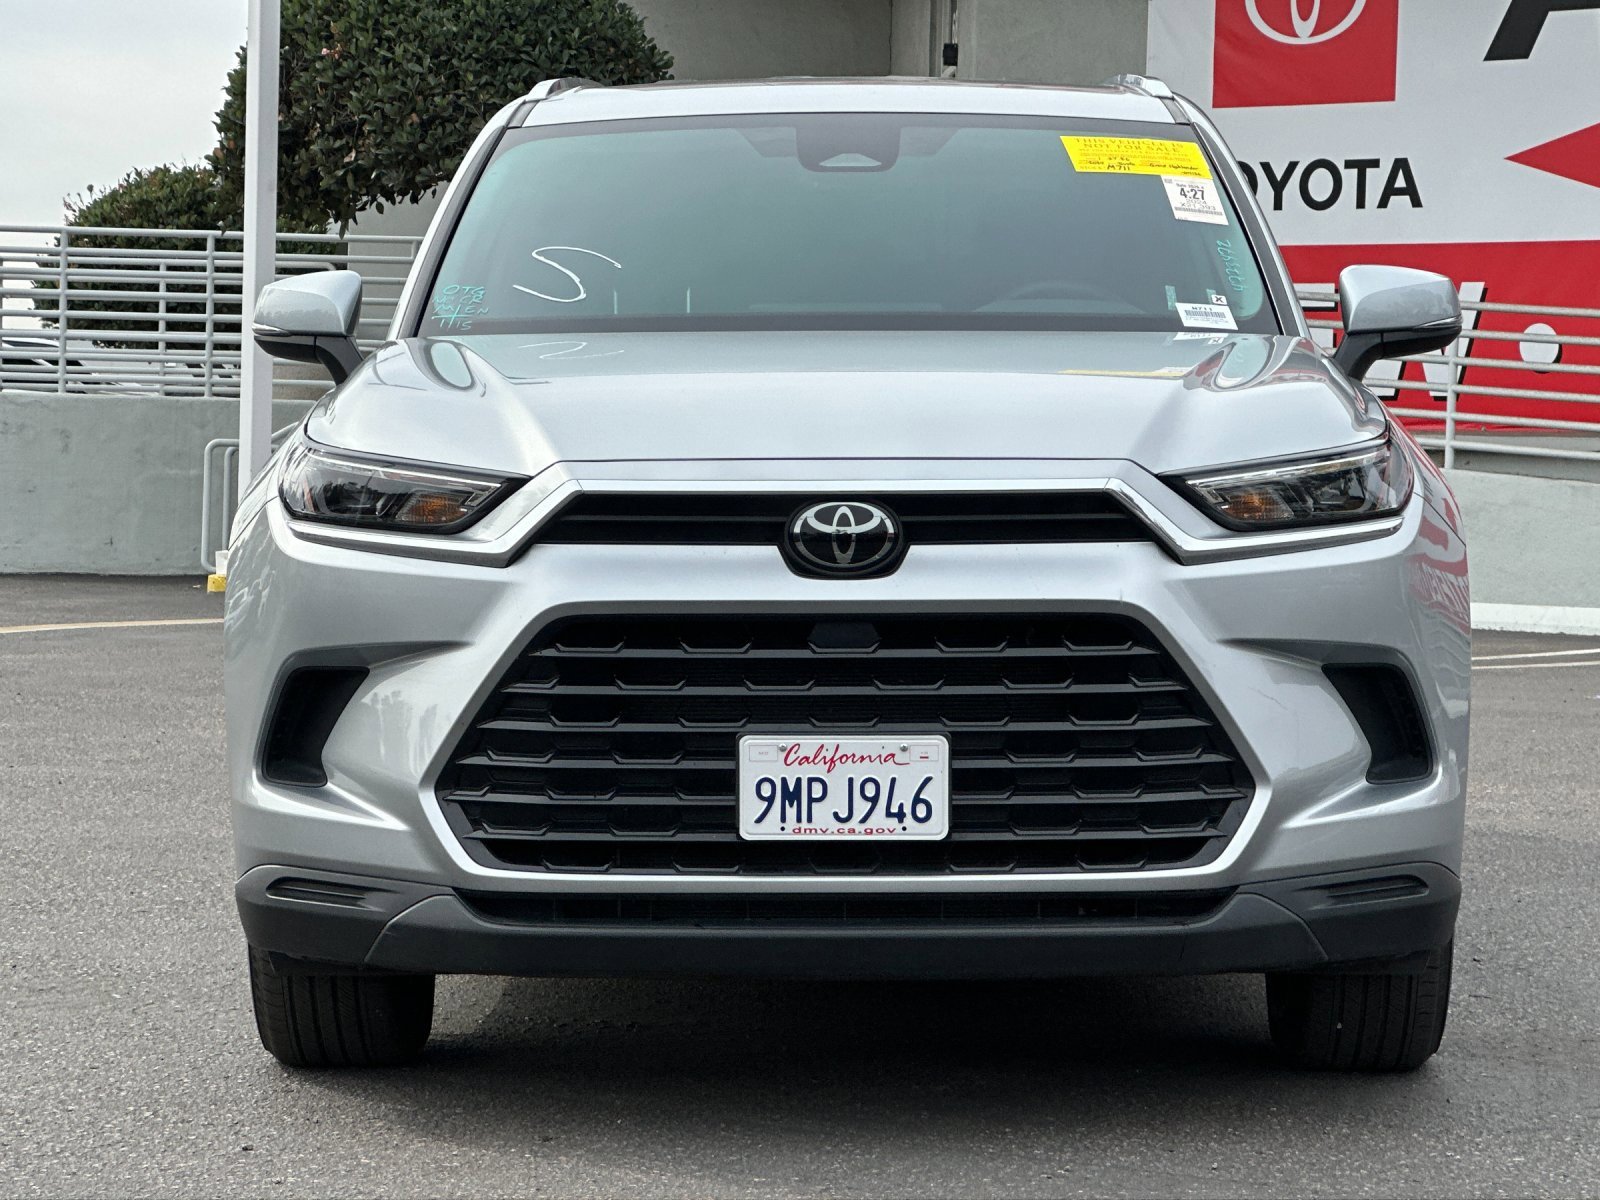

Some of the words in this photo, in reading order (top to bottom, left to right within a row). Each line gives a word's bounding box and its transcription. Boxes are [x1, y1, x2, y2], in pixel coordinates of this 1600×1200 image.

[1109, 138, 1164, 146] VEHICLE
[1179, 187, 1206, 200] 4:27
[1237, 157, 1424, 211] YOTA
[783, 743, 911, 774] California
[753, 776, 934, 824] 9MPJ946
[792, 826, 897, 836] dmv.ca.gov
